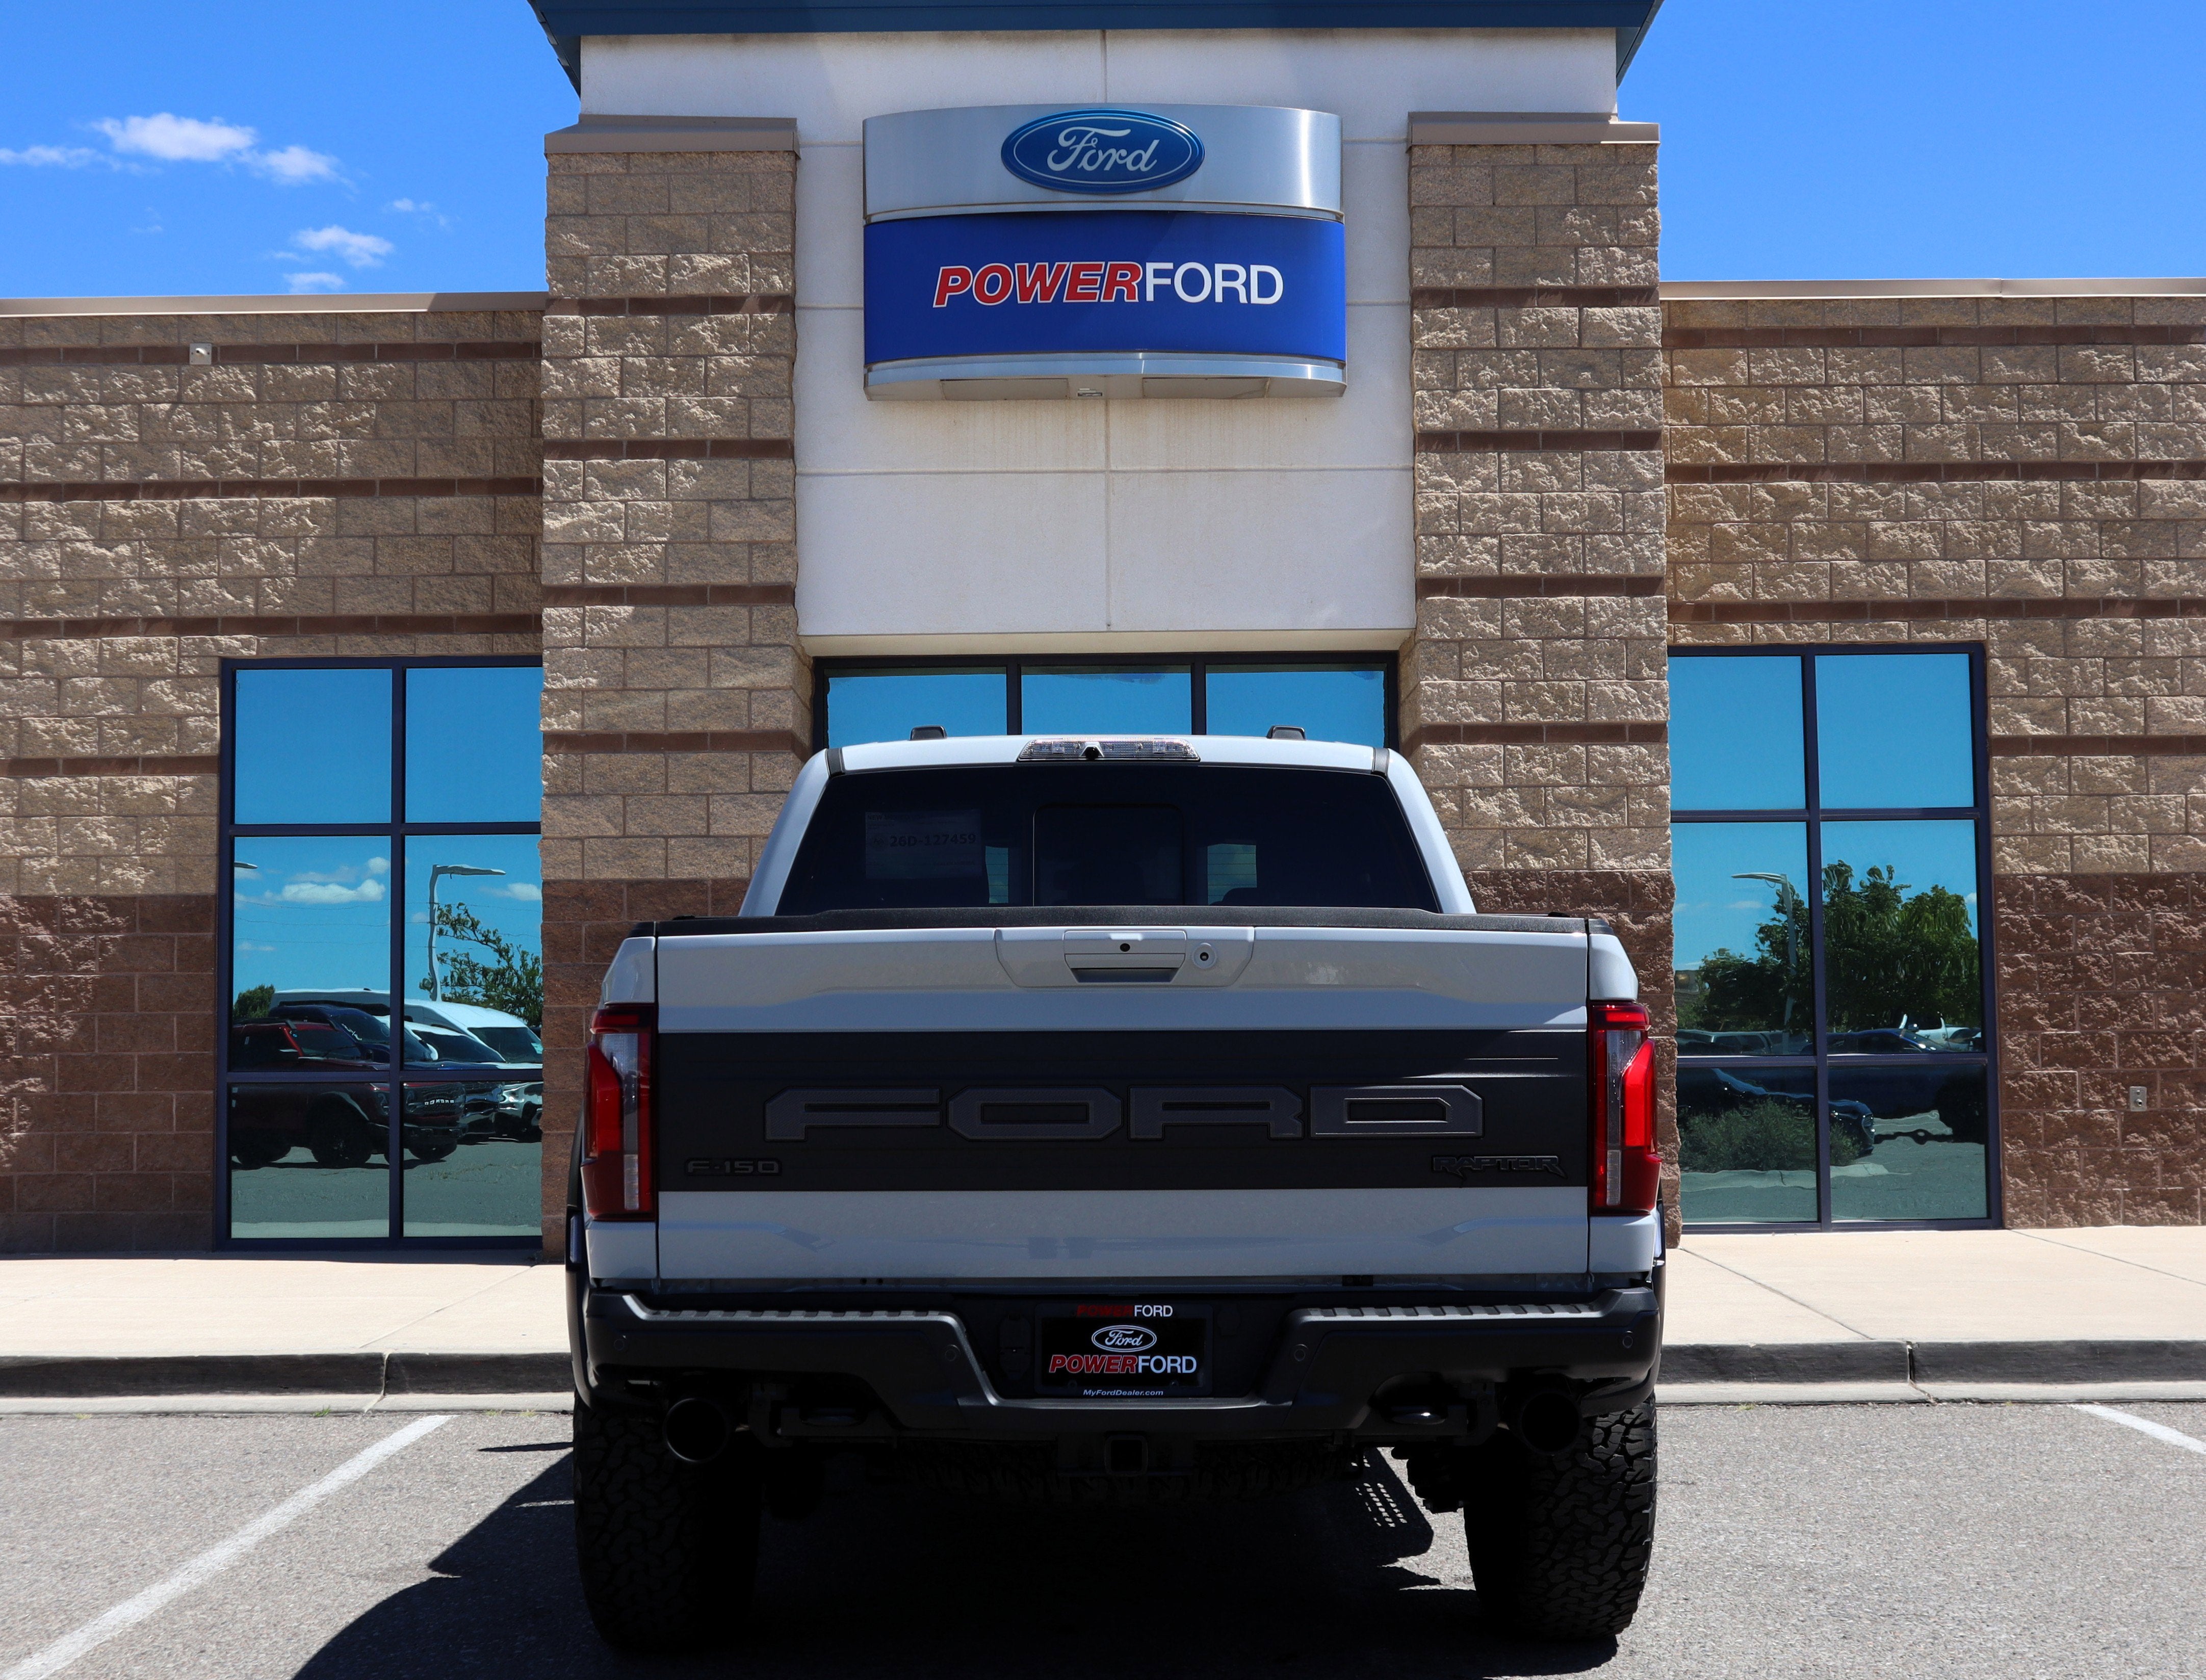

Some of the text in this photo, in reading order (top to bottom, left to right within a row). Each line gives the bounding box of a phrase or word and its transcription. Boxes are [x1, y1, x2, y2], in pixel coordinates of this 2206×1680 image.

[1047, 125, 1160, 172] Ford
[932, 261, 1284, 308] POWERFORD
[890, 833, 976, 847] 26D-127459
[765, 1085, 1484, 1141] FORD
[686, 1159, 780, 1174] F-150
[1432, 1155, 1568, 1179] RAPTOR
[1077, 1304, 1173, 1317] POWERFORD
[1105, 1329, 1143, 1346] Ford
[1049, 1354, 1197, 1373] POWERFORD
